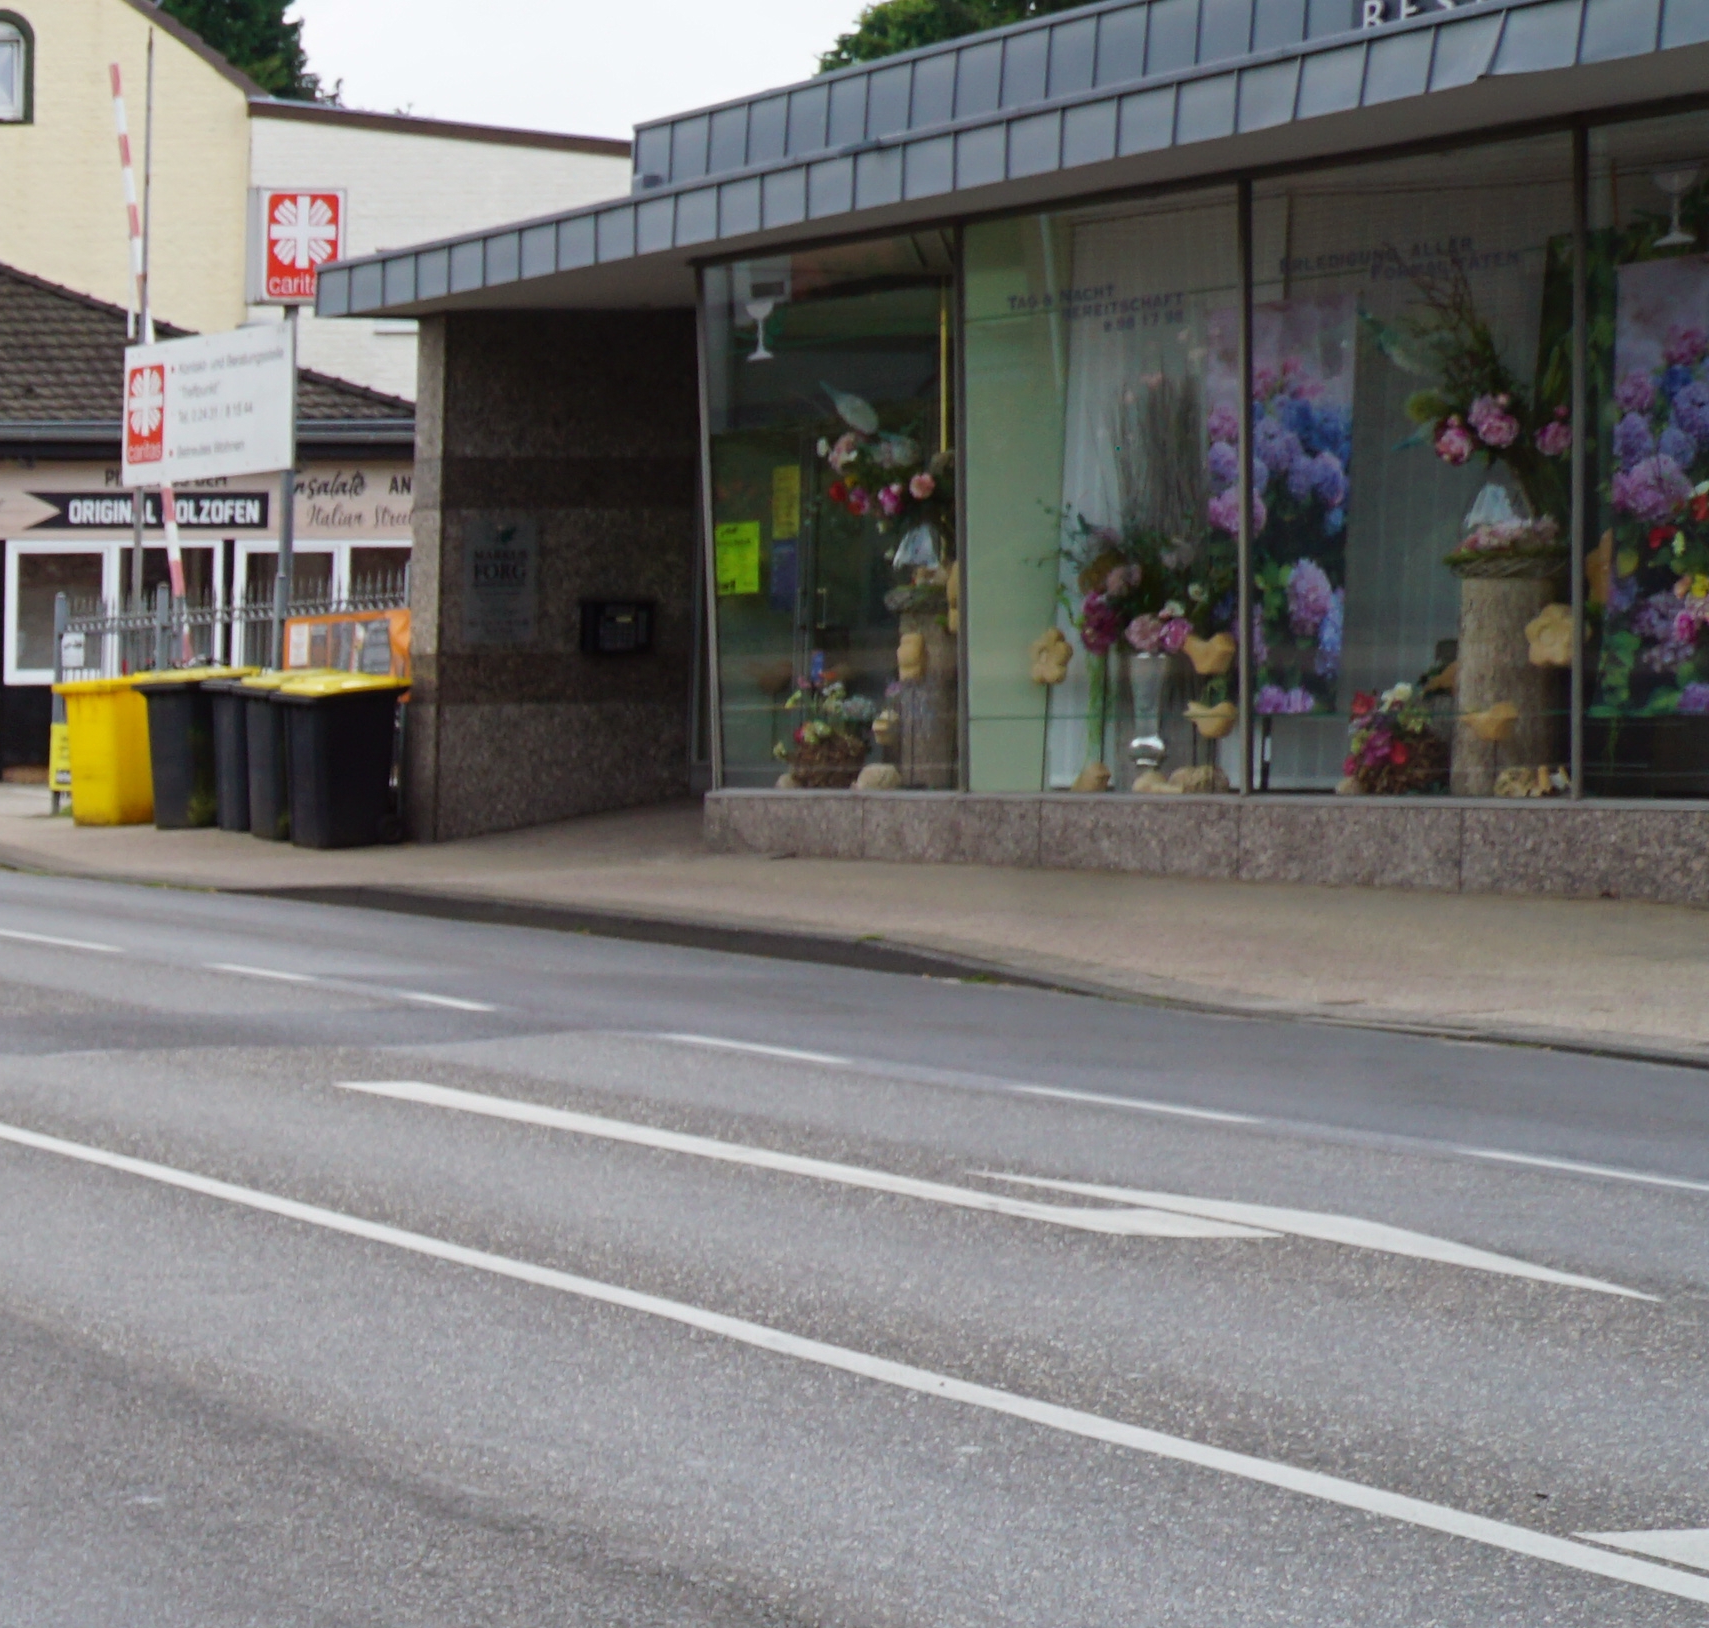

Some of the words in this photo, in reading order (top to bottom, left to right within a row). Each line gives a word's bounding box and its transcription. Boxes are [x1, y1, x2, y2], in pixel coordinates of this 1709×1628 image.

[268, 272, 316, 295] carit
[127, 441, 163, 463] caritas
[68, 499, 157, 525] ORIGINL
[162, 499, 261, 525] OLZOFEN
[306, 503, 364, 529] Italian
